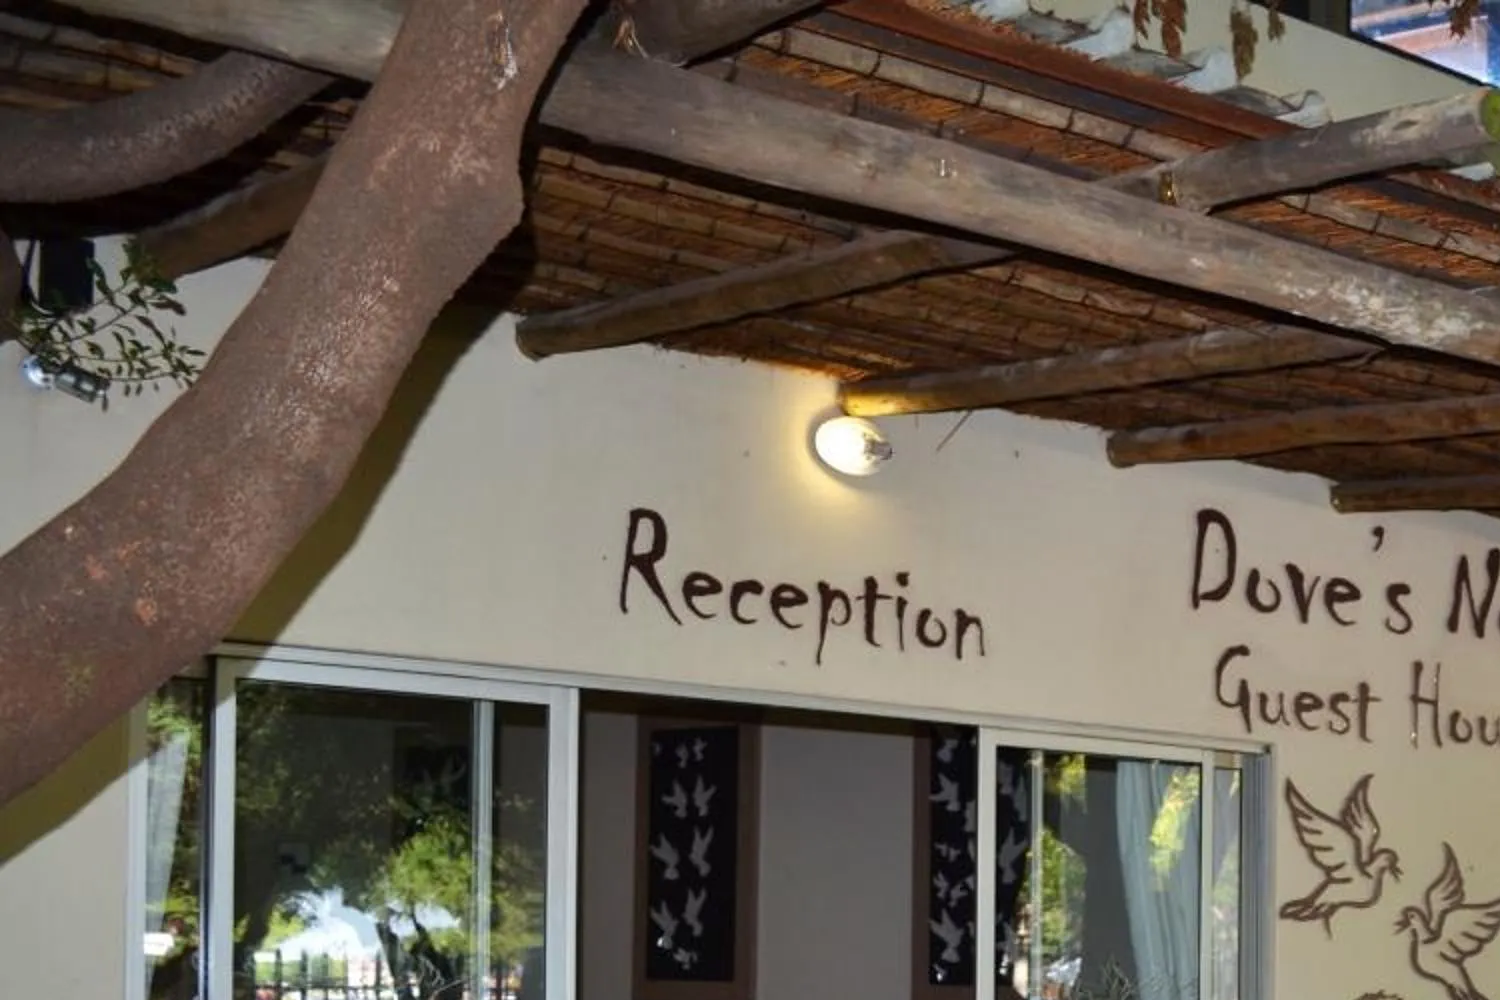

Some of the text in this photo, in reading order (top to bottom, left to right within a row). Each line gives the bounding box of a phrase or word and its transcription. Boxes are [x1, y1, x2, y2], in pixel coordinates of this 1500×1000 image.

[616, 506, 987, 664] Reception
[1188, 506, 1415, 637] Dove's
[1212, 643, 1382, 743] Guest
